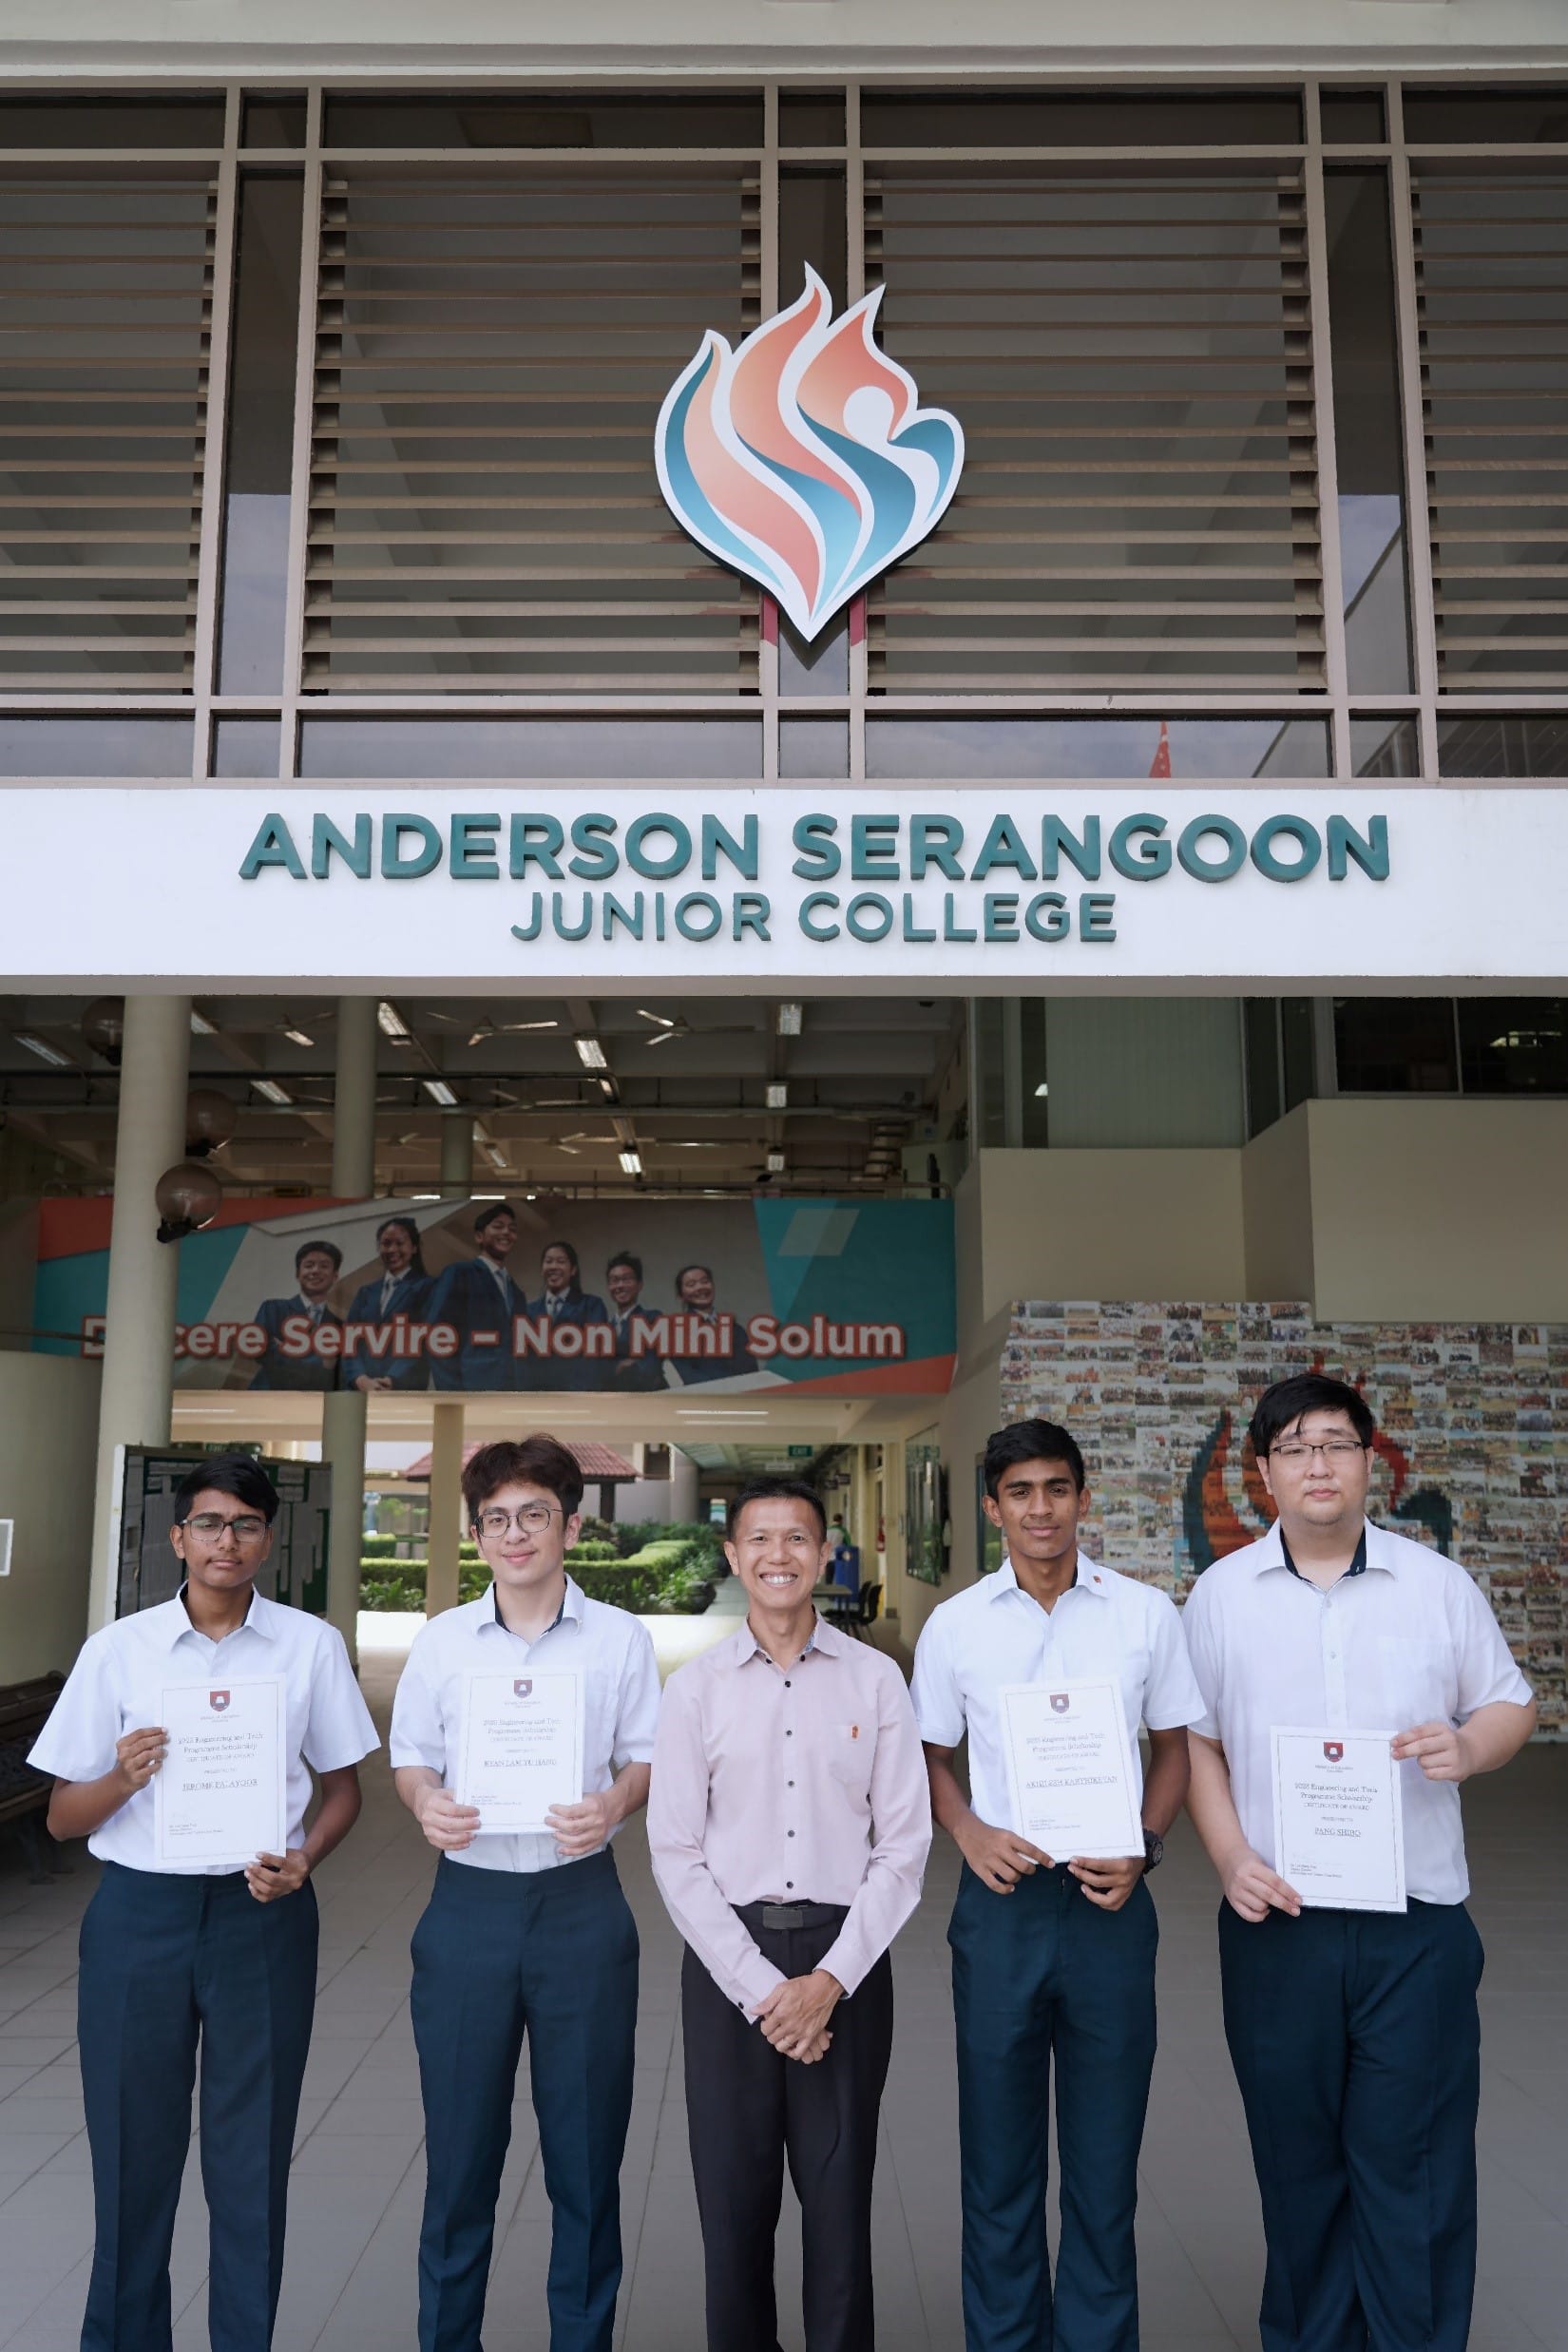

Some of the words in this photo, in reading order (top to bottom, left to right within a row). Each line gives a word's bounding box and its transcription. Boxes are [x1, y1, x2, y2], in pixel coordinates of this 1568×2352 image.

[239, 812, 758, 881] ANDERSON
[792, 813, 1390, 882] SERANGOON
[510, 890, 771, 942] JUNIOR
[798, 891, 1117, 943] COLLEGE
[280, 1314, 458, 1357] Servire
[514, 1315, 616, 1357] Non
[630, 1313, 733, 1357] Mihi
[746, 1314, 905, 1358] Solum
